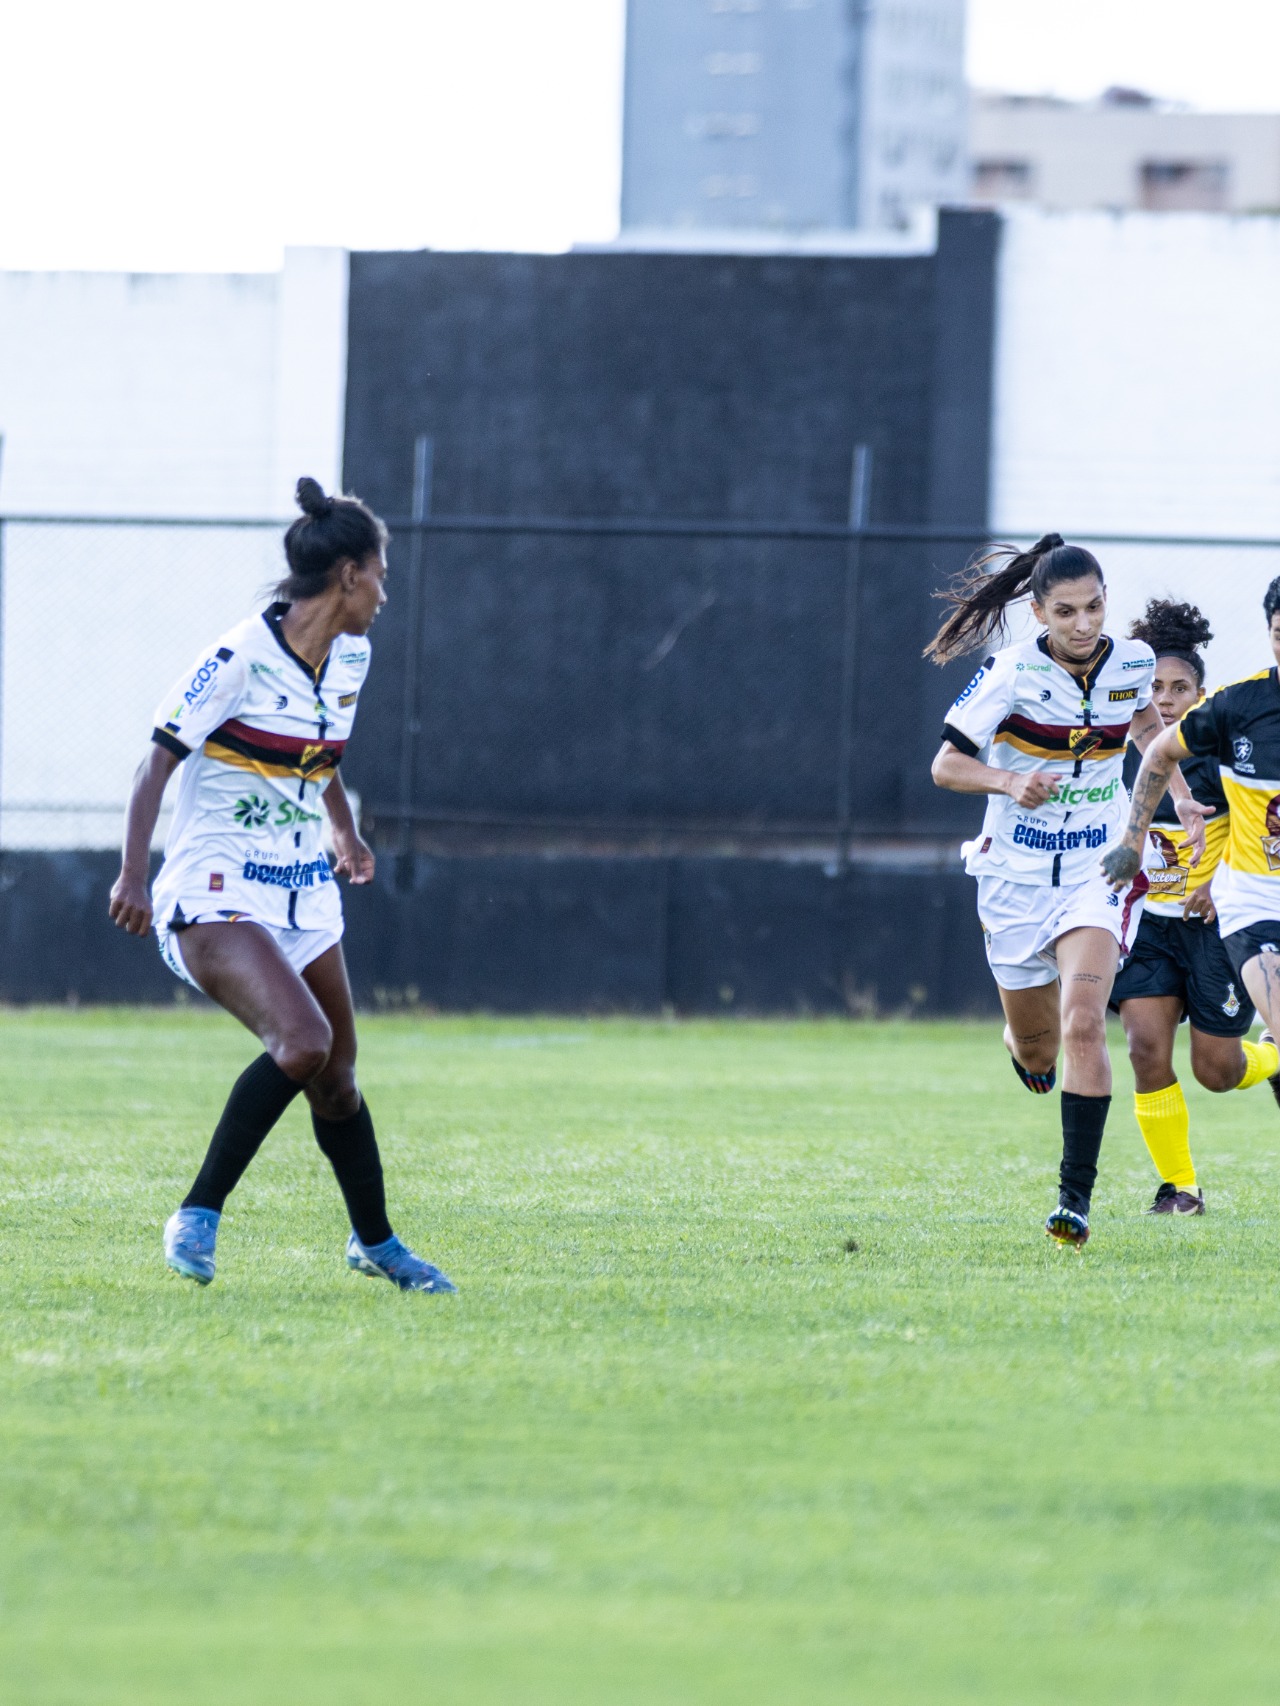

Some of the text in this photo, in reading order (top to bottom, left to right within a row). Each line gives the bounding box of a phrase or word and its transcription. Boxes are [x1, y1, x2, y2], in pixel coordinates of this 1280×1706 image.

[184, 658, 218, 706] AGOS
[1110, 690, 1134, 701] THOR
[1070, 731, 1082, 742] PEC
[1017, 815, 1048, 828] GRUPO
[1013, 823, 1107, 851] equatorial
[245, 849, 279, 861] GRUPO
